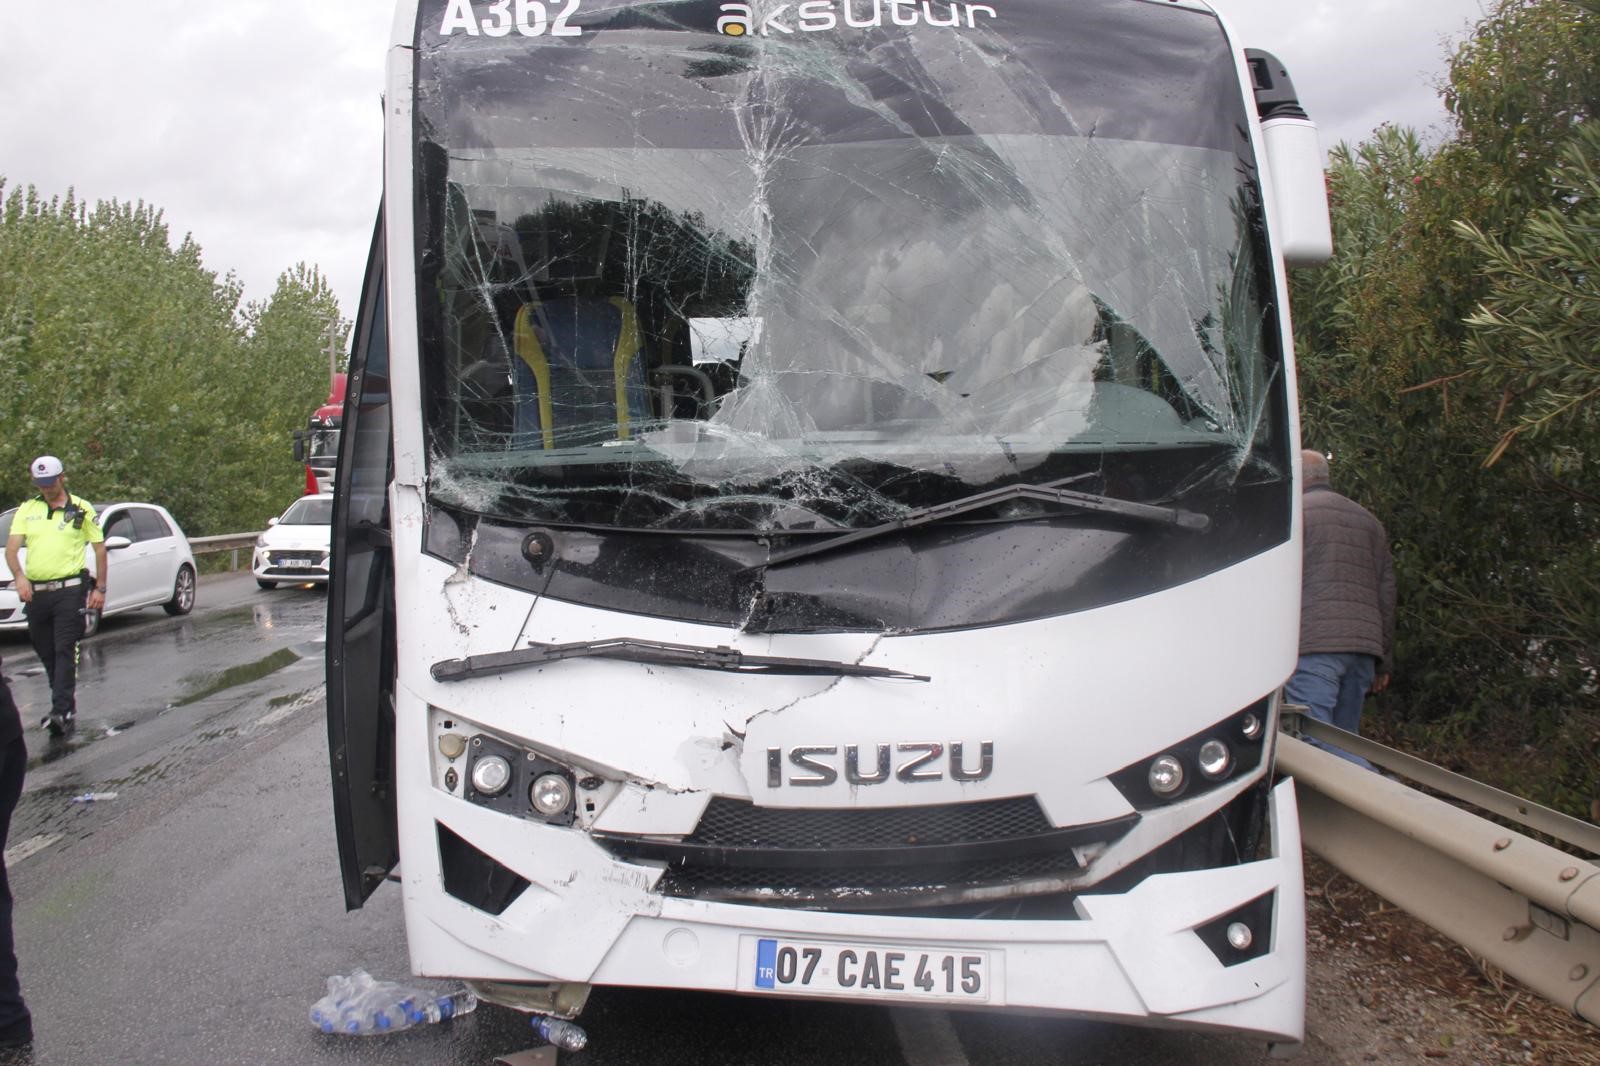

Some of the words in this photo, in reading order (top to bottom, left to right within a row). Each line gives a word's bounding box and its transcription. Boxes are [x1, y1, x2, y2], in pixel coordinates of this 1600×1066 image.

[439, 0, 582, 37] A362
[767, 740, 993, 788] ISUZU
[759, 967, 773, 979] TR
[776, 946, 822, 984] 07
[837, 949, 905, 990] CAE
[914, 954, 982, 994] 415
